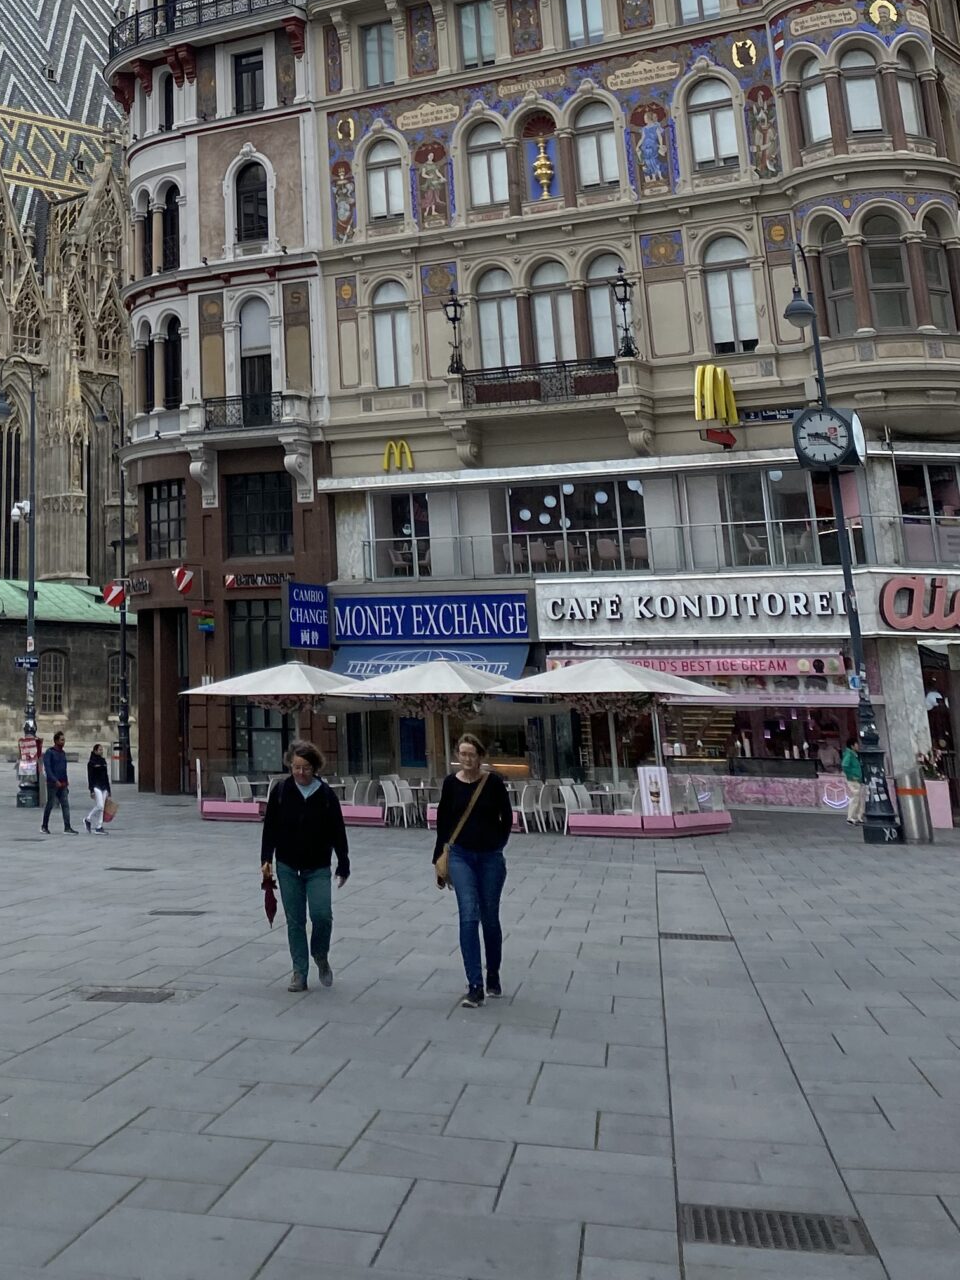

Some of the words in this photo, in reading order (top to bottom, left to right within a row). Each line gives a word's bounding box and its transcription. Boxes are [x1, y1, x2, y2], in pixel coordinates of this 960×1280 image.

[293, 588, 324, 603] CAMBIO
[632, 591, 847, 620] KONDITOREI
[289, 607, 329, 625] CHANGE
[334, 605, 407, 637] MONEY
[411, 601, 529, 636] EXCHANGE
[347, 662, 377, 675] THE
[681, 660, 712, 672] BEST
[716, 660, 739, 672] ICE
